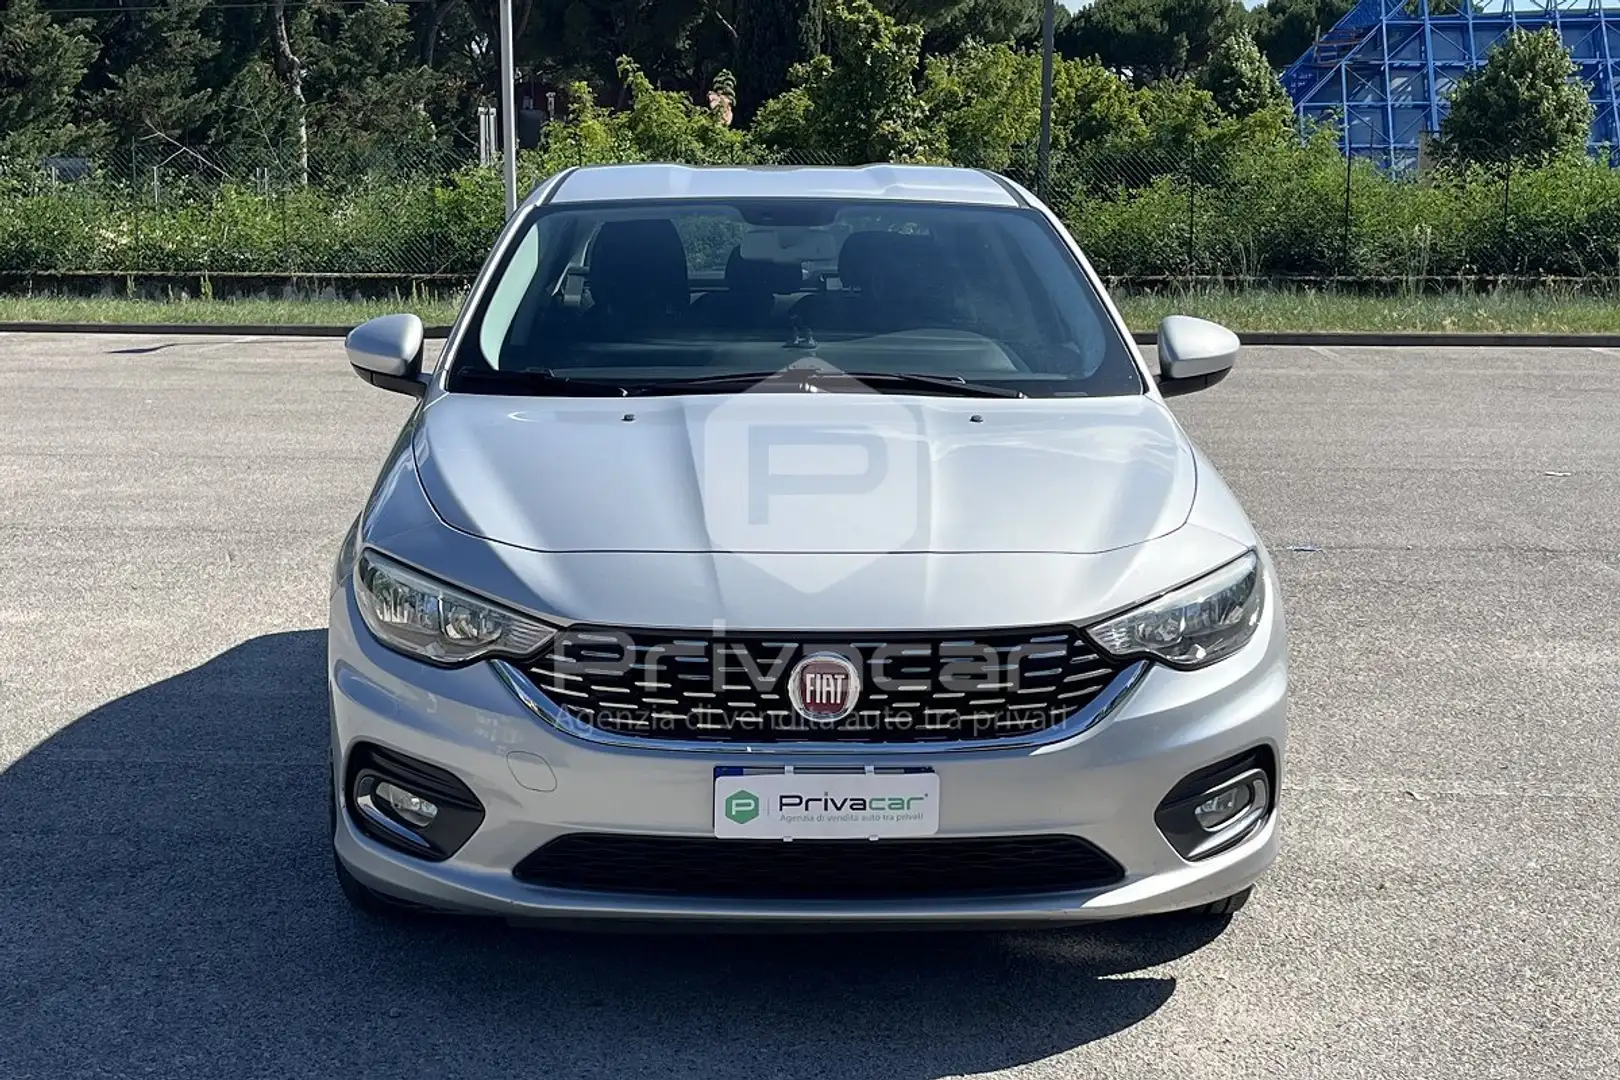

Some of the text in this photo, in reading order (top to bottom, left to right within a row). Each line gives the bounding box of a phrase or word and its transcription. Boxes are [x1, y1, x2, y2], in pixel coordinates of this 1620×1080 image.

[806, 673, 845, 703] FIAT
[779, 791, 926, 812] Privacar
[780, 814, 815, 823] Agenzia
[827, 814, 859, 822] vendita
[861, 814, 881, 822] auto
[896, 813, 924, 822] privati
